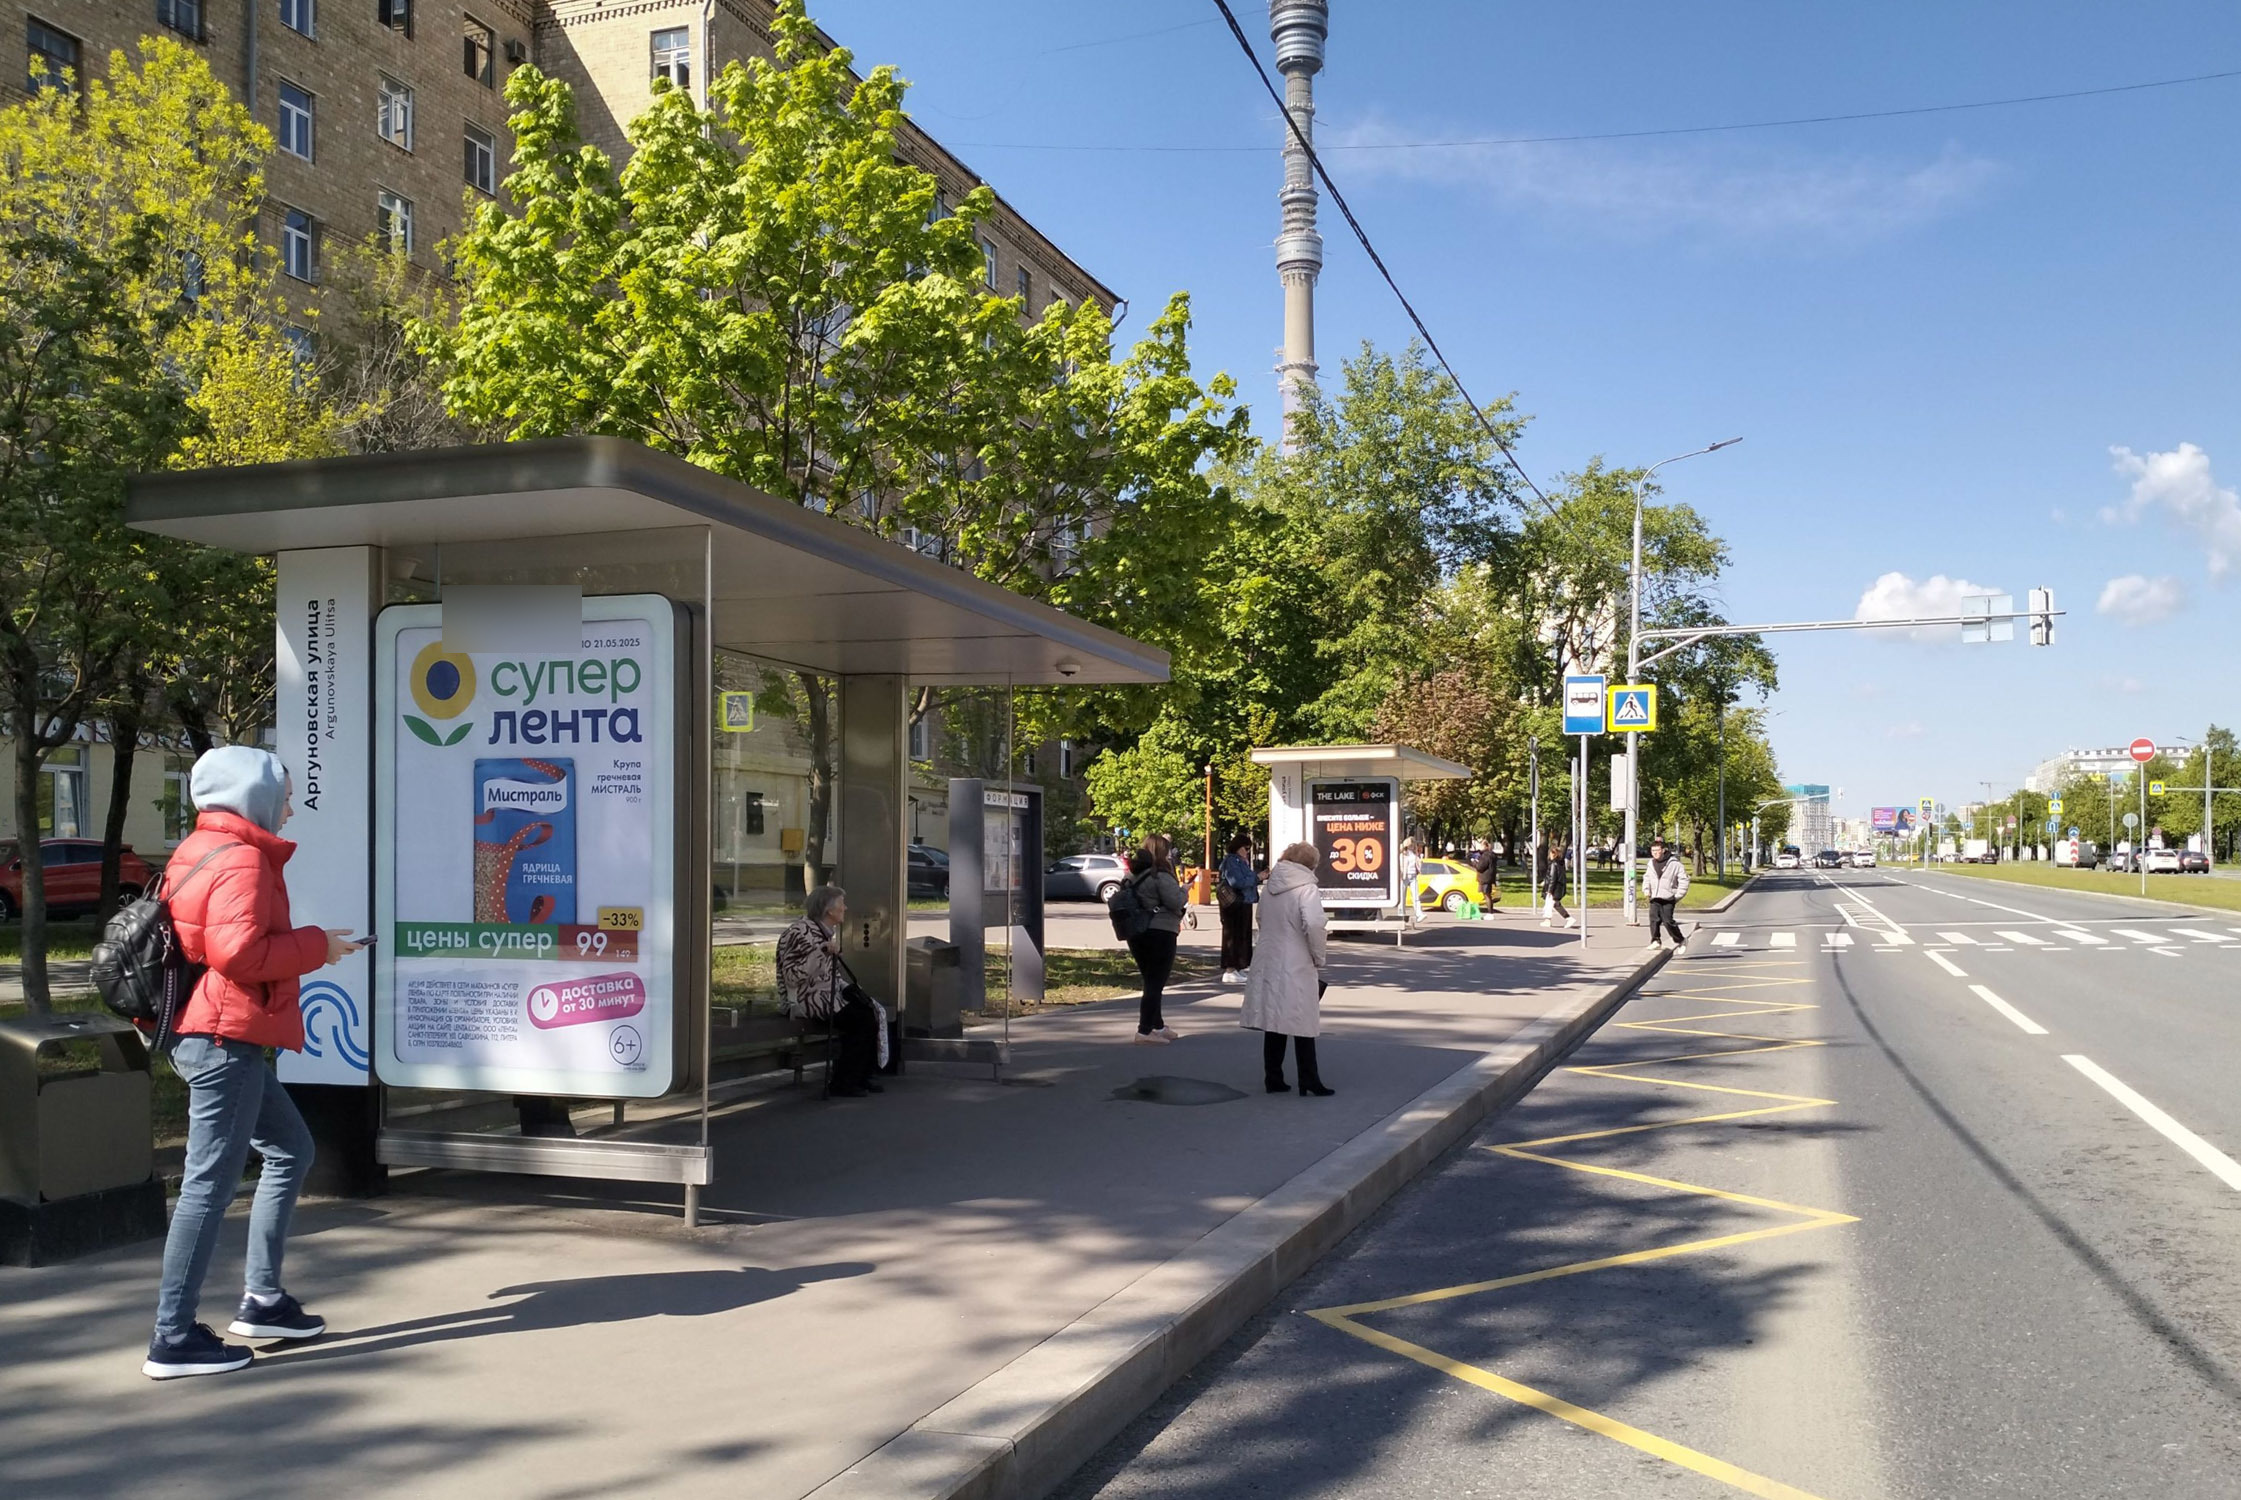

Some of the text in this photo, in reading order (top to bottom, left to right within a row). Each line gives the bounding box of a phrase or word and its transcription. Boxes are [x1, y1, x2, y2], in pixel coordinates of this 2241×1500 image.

[594, 637, 641, 649] 21.05.2025
[325, 598, 338, 739] Argunovskaya Ulitsa
[490, 657, 642, 706] супер
[304, 599, 322, 811] Аргуновская улица
[488, 707, 643, 745] лента
[613, 759, 642, 771] Крупа
[597, 774, 642, 783] гречневая
[488, 787, 563, 806] Мистраль
[591, 784, 642, 795] МИСТРАЛЬ
[1317, 791, 1355, 800] THE LAKE
[1326, 821, 1385, 833] ЦЕНА НИЖЕ
[1331, 837, 1383, 872] 30
[522, 862, 561, 873] ЯДРИЦА
[1347, 872, 1379, 880] СКИДКА
[522, 874, 573, 884] ГРЕЧНЕВАЯ
[407, 930, 553, 957] цены супер
[575, 931, 608, 957] 99
[561, 978, 635, 1002] доставка
[562, 994, 635, 1013] от 30 минут
[614, 1035, 637, 1054] 6+
